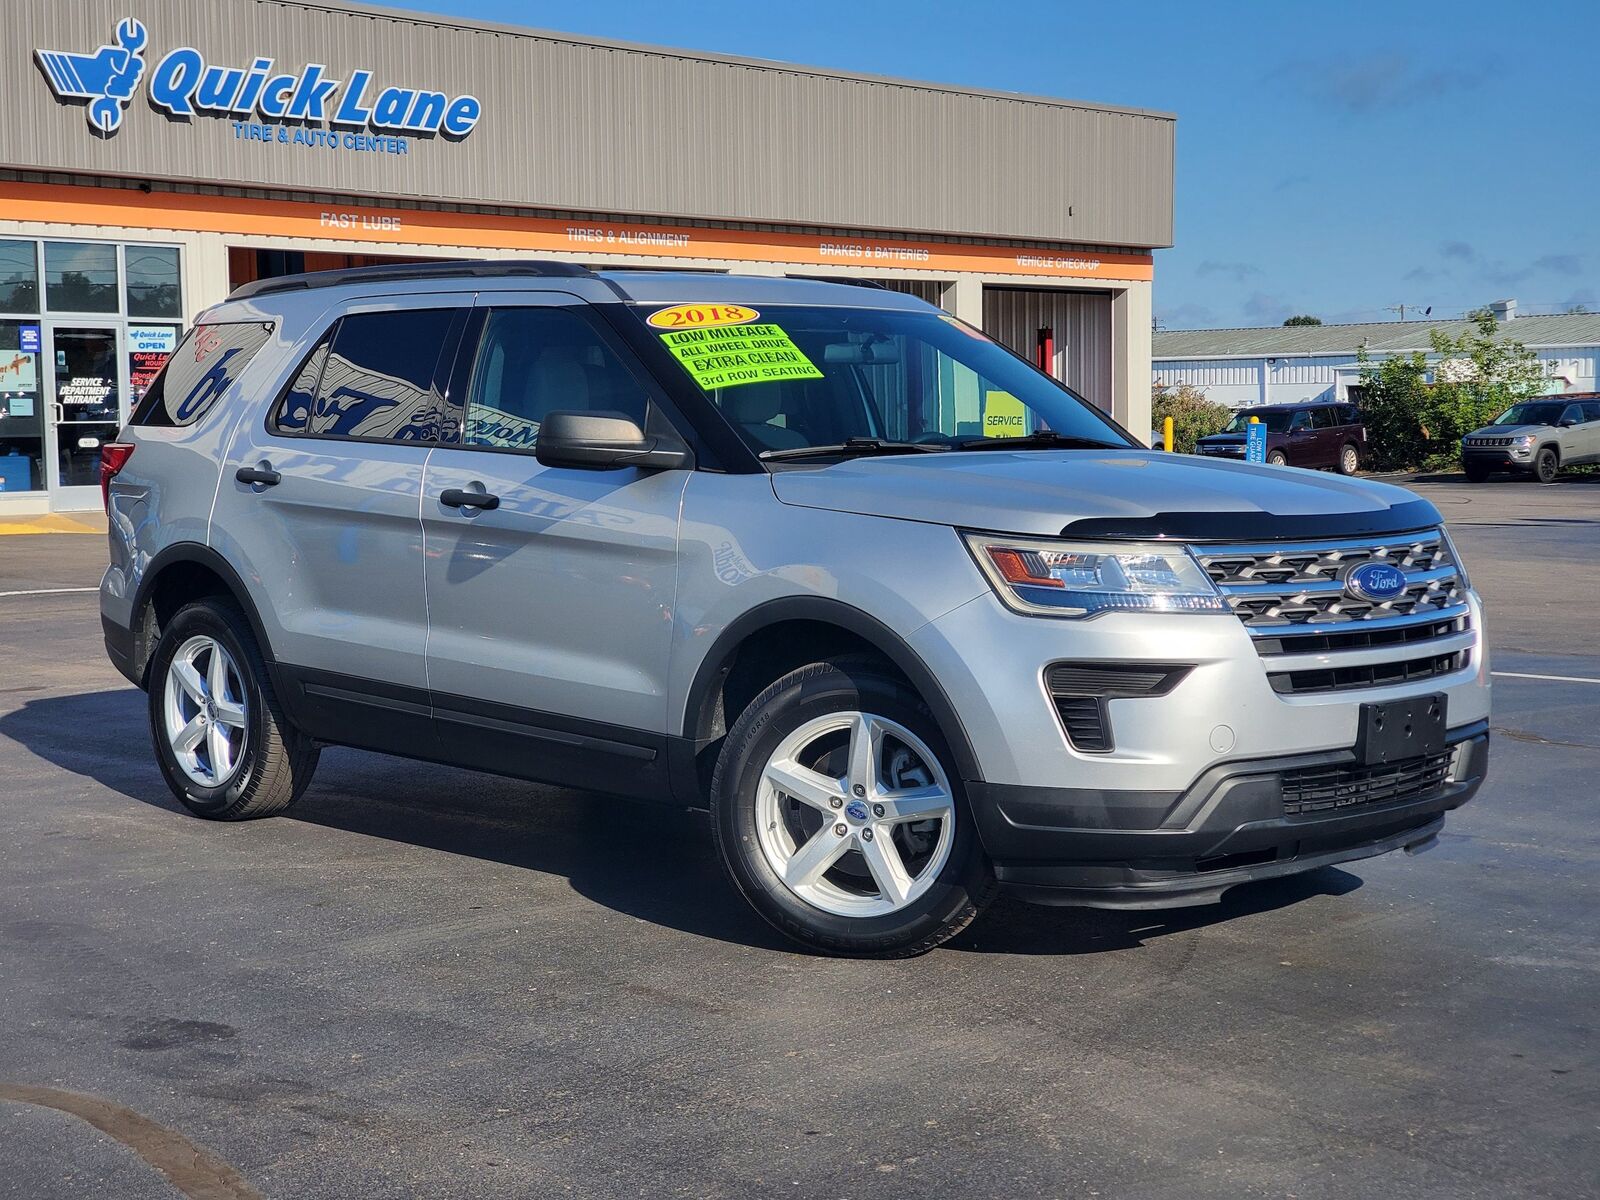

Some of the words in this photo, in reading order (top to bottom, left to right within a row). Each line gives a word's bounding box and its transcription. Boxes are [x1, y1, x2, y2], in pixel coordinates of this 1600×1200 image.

[150, 46, 341, 121] Quick
[332, 70, 482, 136] Lane
[233, 122, 273, 143] TIRE
[277, 127, 290, 146] &
[293, 129, 340, 150] AUTO
[344, 133, 408, 155] CENTER
[320, 212, 358, 229] FAST
[363, 215, 402, 232] LUBE
[566, 227, 604, 243] TIRES
[606, 230, 616, 243] &
[619, 230, 690, 248] ALIGNMENT
[819, 243, 862, 258] BRAKES
[865, 246, 872, 258] &
[875, 246, 929, 262] BATTERIES
[1016, 254, 1054, 269] VEHICLE
[1056, 257, 1101, 271] CHECK-UP
[665, 305, 743, 327] 2018
[139, 330, 157, 339] Quick
[671, 328, 705, 345] LOW
[710, 325, 776, 340] MILEAGE
[138, 342, 166, 350] OPEN
[680, 343, 706, 359] ALL
[709, 340, 749, 355] WHEEL
[751, 338, 788, 351] DRIVE
[133, 352, 156, 361] Quick
[693, 354, 746, 372] EXTRA
[750, 350, 798, 365] CLEAN
[71, 377, 104, 387] SERVICE
[701, 373, 725, 386] 3rd
[727, 370, 760, 383] ROW
[762, 365, 817, 379] SEATING
[59, 386, 112, 396] DEPARTMENT
[63, 395, 105, 404] ENTRANCE
[987, 415, 1023, 426] SERVICE
[1369, 569, 1401, 590] Ford
